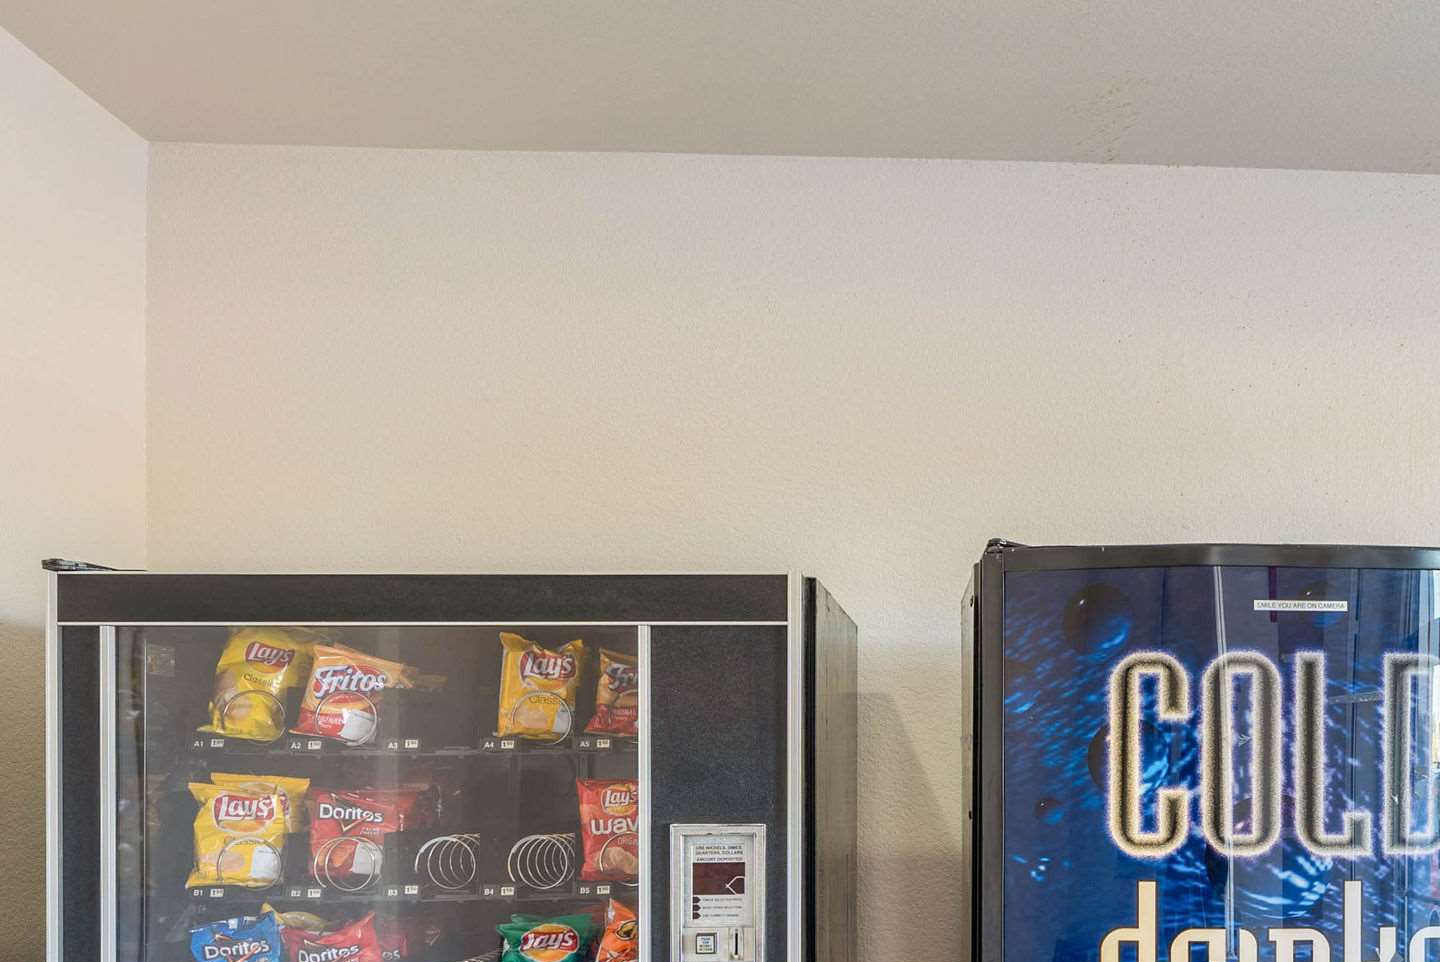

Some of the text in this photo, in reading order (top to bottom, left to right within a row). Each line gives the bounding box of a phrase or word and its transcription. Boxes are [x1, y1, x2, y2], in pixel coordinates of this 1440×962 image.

[313, 664, 386, 699] Fritos
[319, 803, 384, 823] Doritos
[204, 940, 270, 959] Doritos
